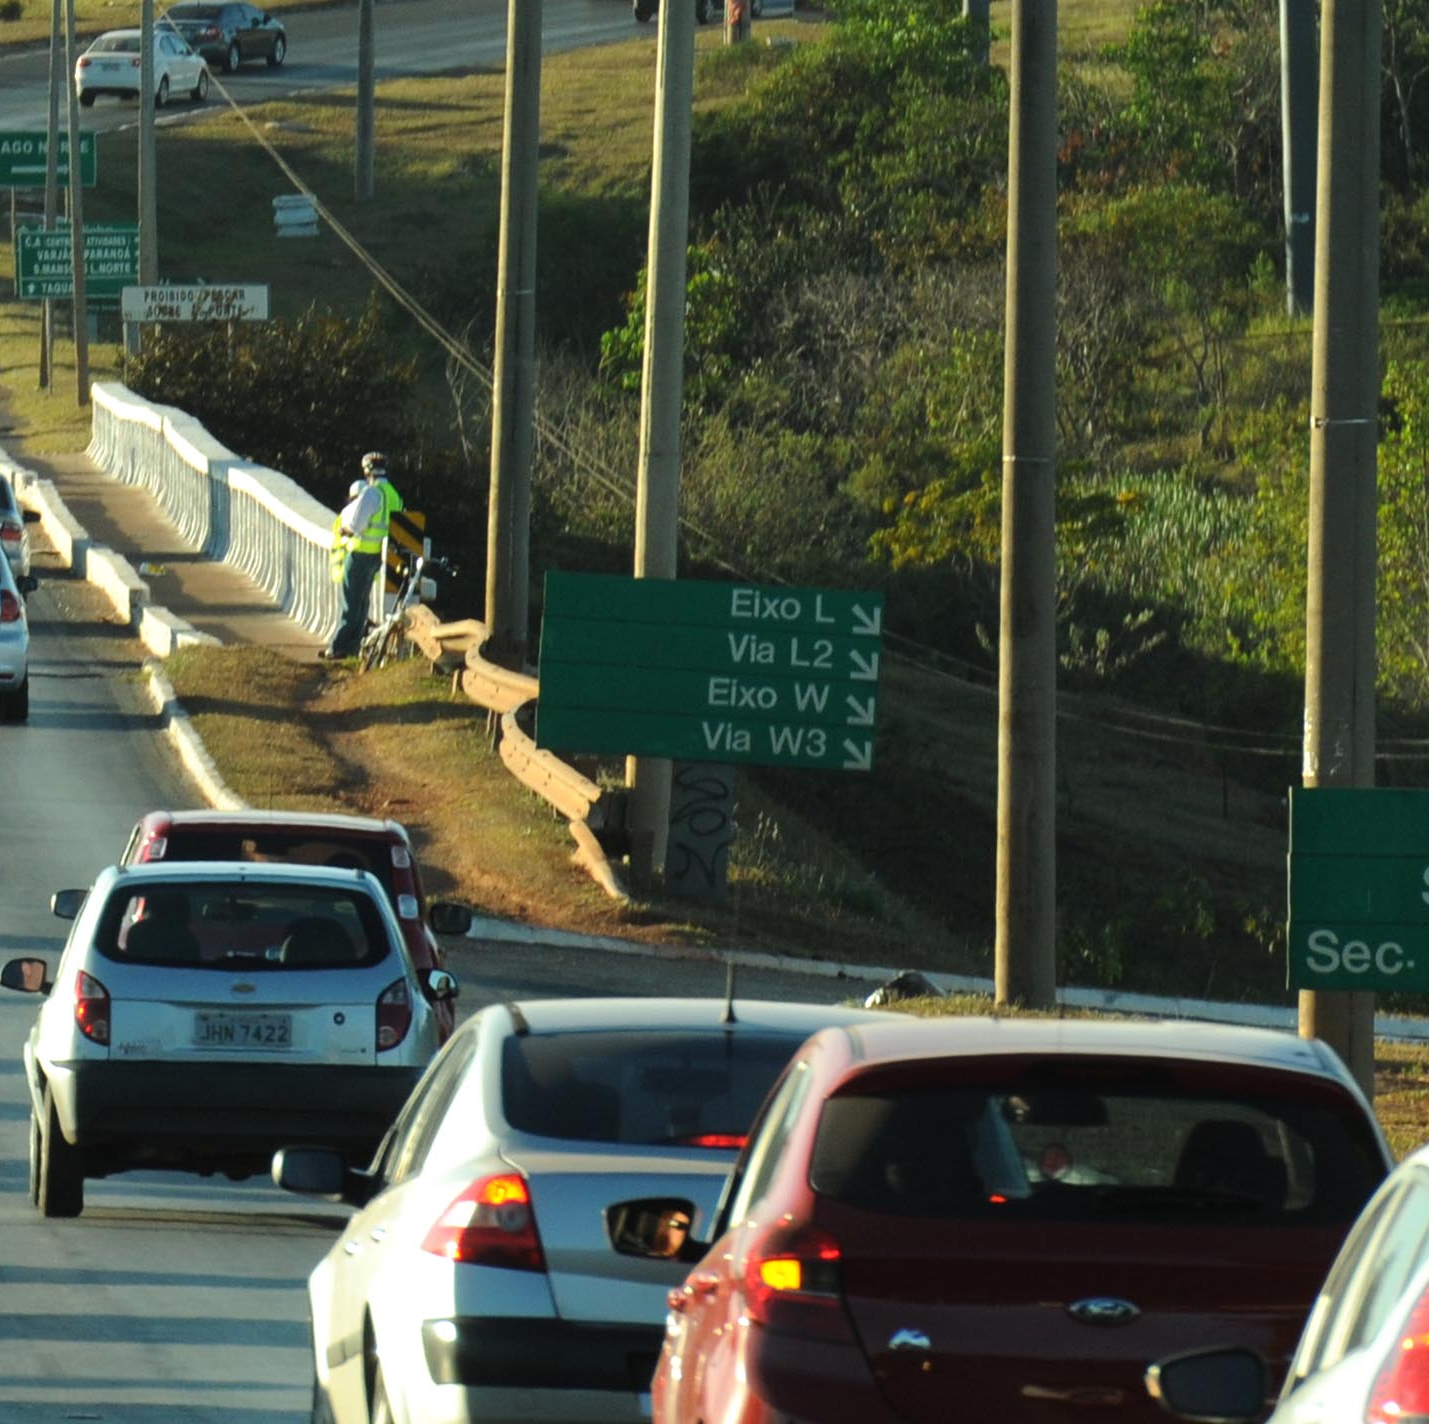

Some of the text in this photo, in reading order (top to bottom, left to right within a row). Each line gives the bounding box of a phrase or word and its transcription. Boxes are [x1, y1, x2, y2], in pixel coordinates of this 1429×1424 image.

[38, 141, 89, 154] NRE
[37, 248, 71, 261] VARJÃ
[144, 290, 194, 302] PROIBIDO
[731, 588, 835, 623] Eixo L
[727, 632, 834, 669] Via L2
[707, 677, 830, 713] Eixo W
[702, 721, 827, 757] Via W3
[1306, 929, 1415, 975] Sec.
[203, 1025, 289, 1043] JHN 7422
